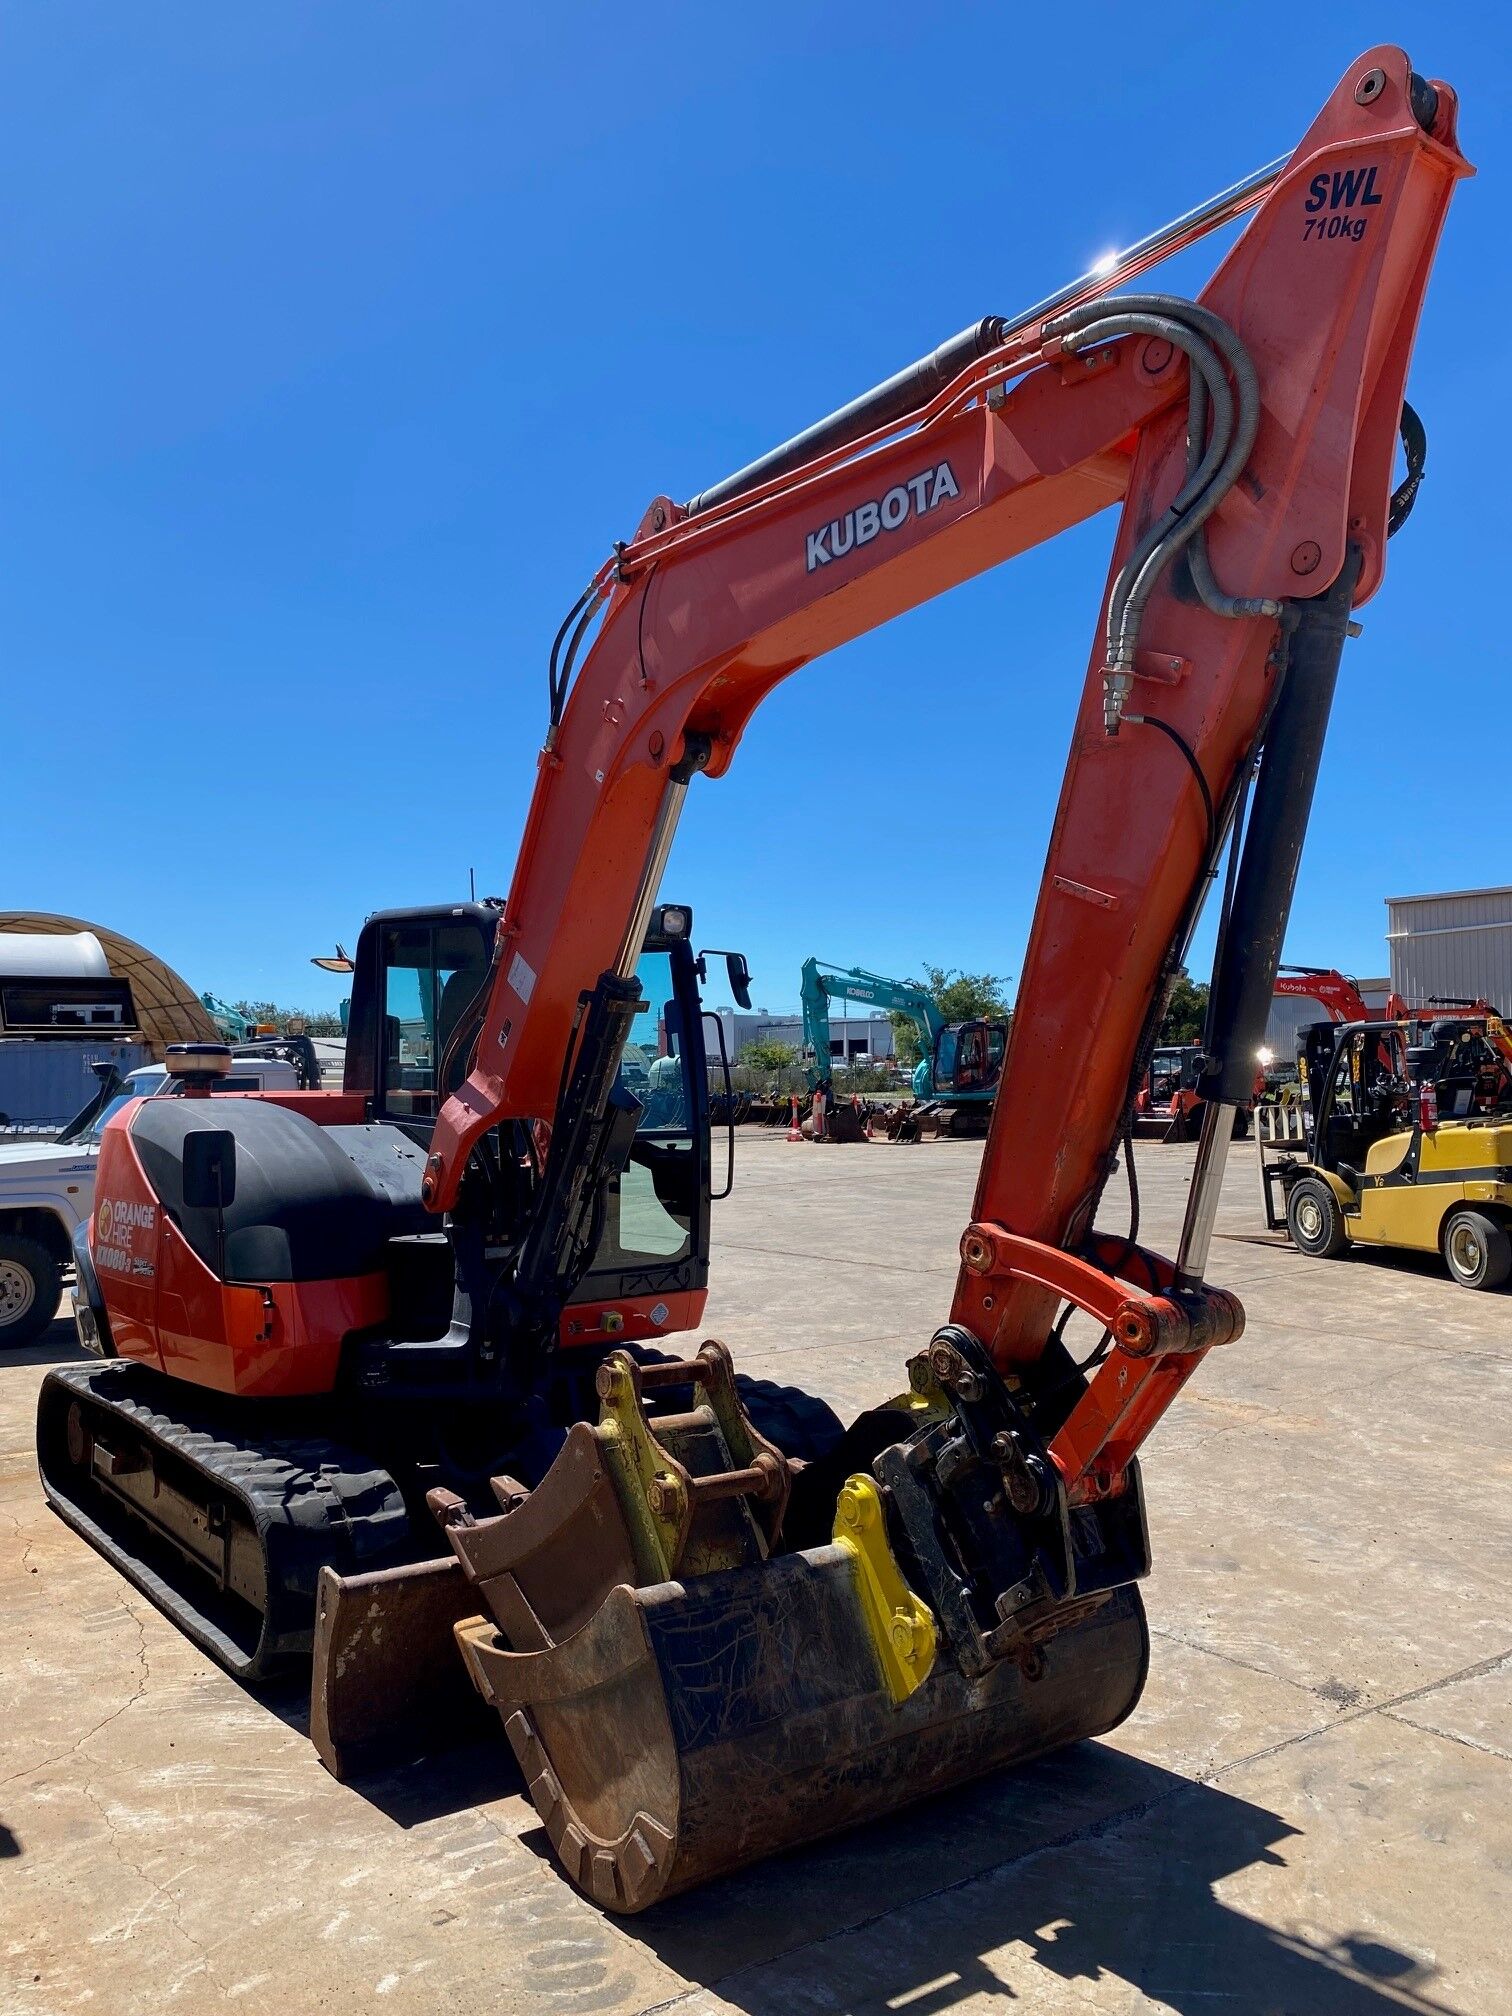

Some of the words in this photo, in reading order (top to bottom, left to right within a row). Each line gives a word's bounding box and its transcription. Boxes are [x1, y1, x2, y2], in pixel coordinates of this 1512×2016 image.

[1305, 166, 1383, 213] SWL
[1303, 214, 1368, 242] 710kg
[805, 461, 960, 573] KUBOTA
[846, 986, 875, 999] KOBELCO
[1280, 982, 1307, 992] Kubota
[113, 1201, 156, 1229] ORANGE
[112, 1222, 134, 1249] HIRE
